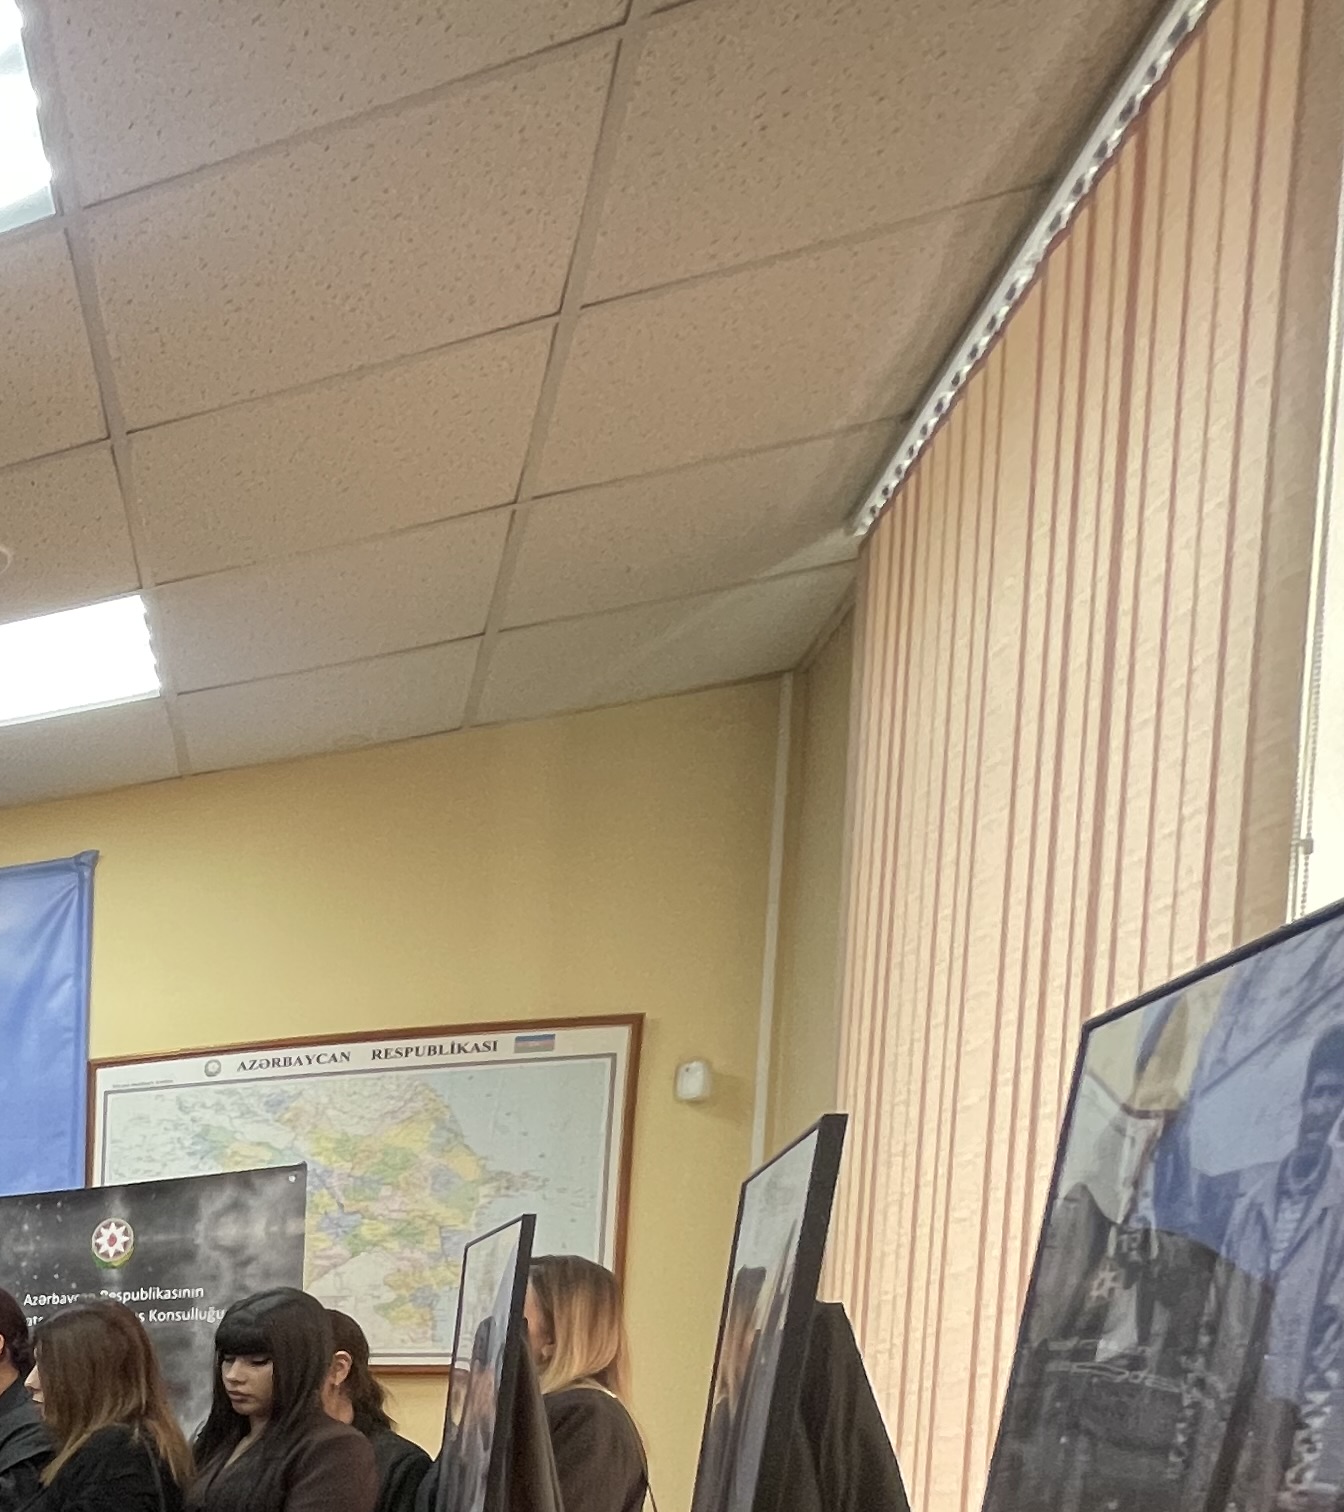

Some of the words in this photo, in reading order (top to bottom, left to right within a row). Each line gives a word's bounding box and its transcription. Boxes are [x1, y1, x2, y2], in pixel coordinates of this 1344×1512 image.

[237, 1051, 351, 1072] AZƏRBAYCAN
[371, 1039, 499, 1061] RESPUBLİKASI
[23, 1293, 96, 1306] Azərbay
[149, 1306, 225, 1322] Konsulluğu
